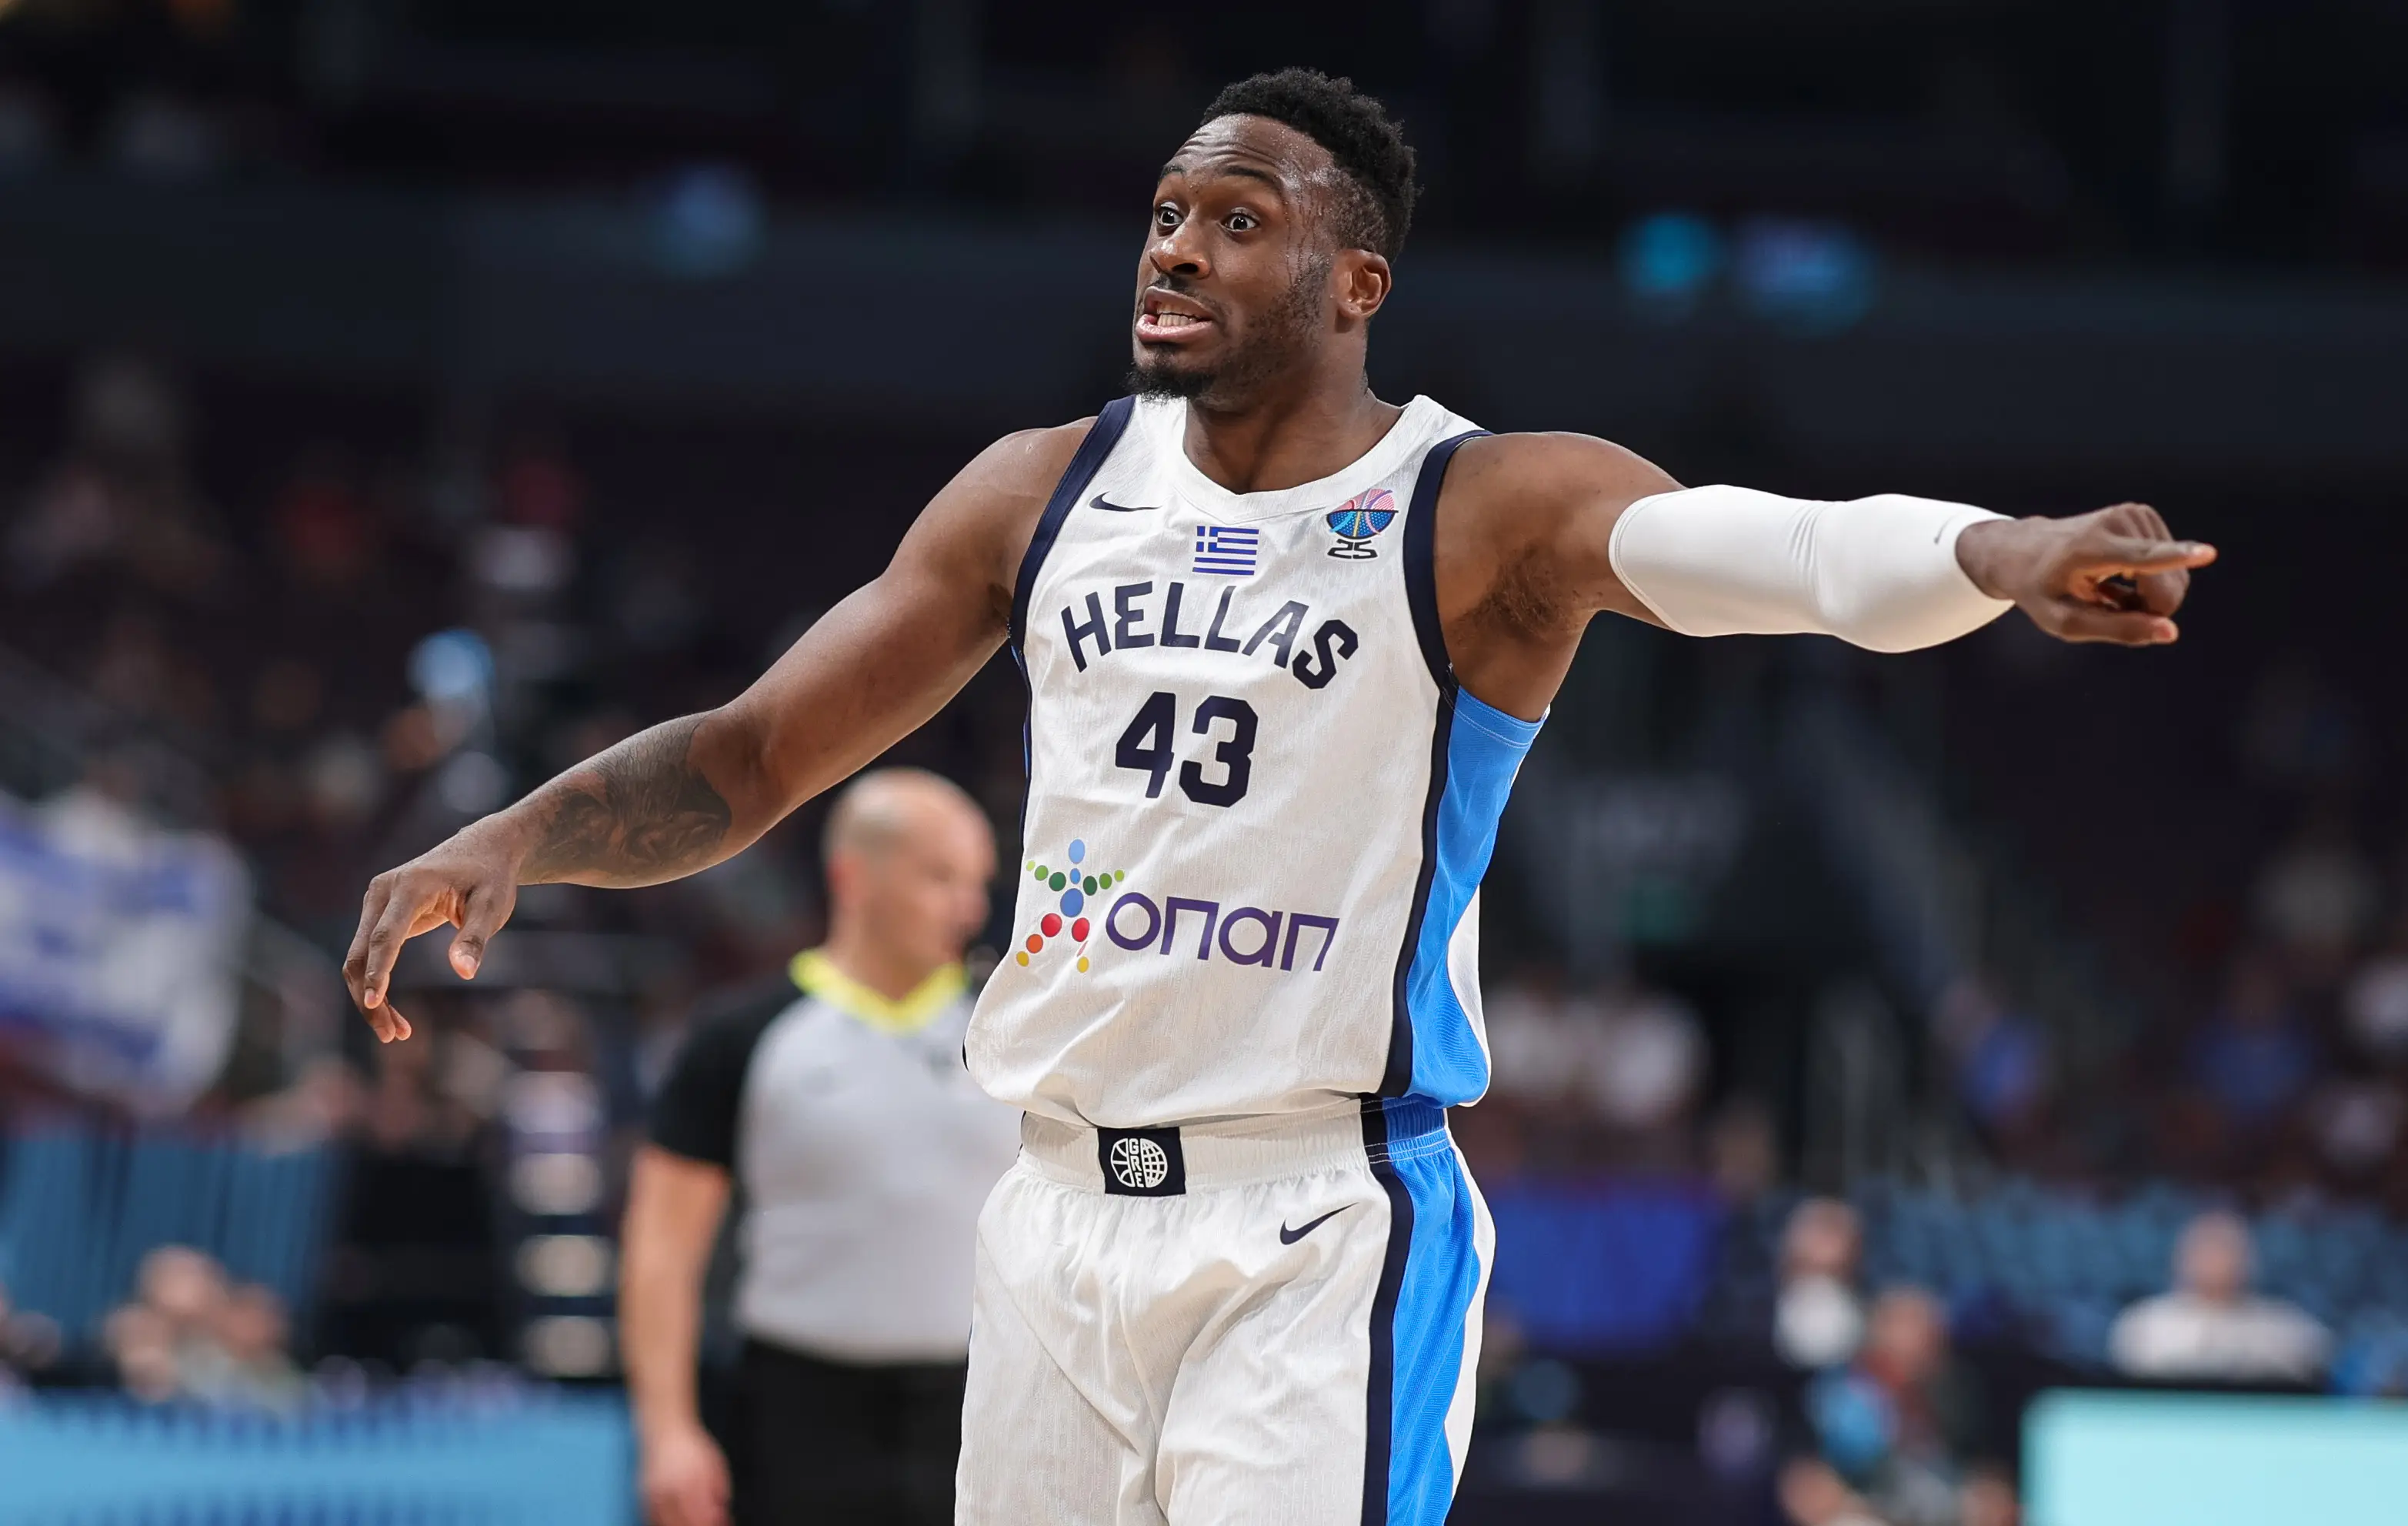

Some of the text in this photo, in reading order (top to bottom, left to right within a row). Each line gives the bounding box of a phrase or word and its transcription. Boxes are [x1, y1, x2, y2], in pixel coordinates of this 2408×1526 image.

[1061, 581, 1359, 690] HELLAS
[1115, 691, 1259, 808] 43
[1129, 1138, 1145, 1187] GRE
